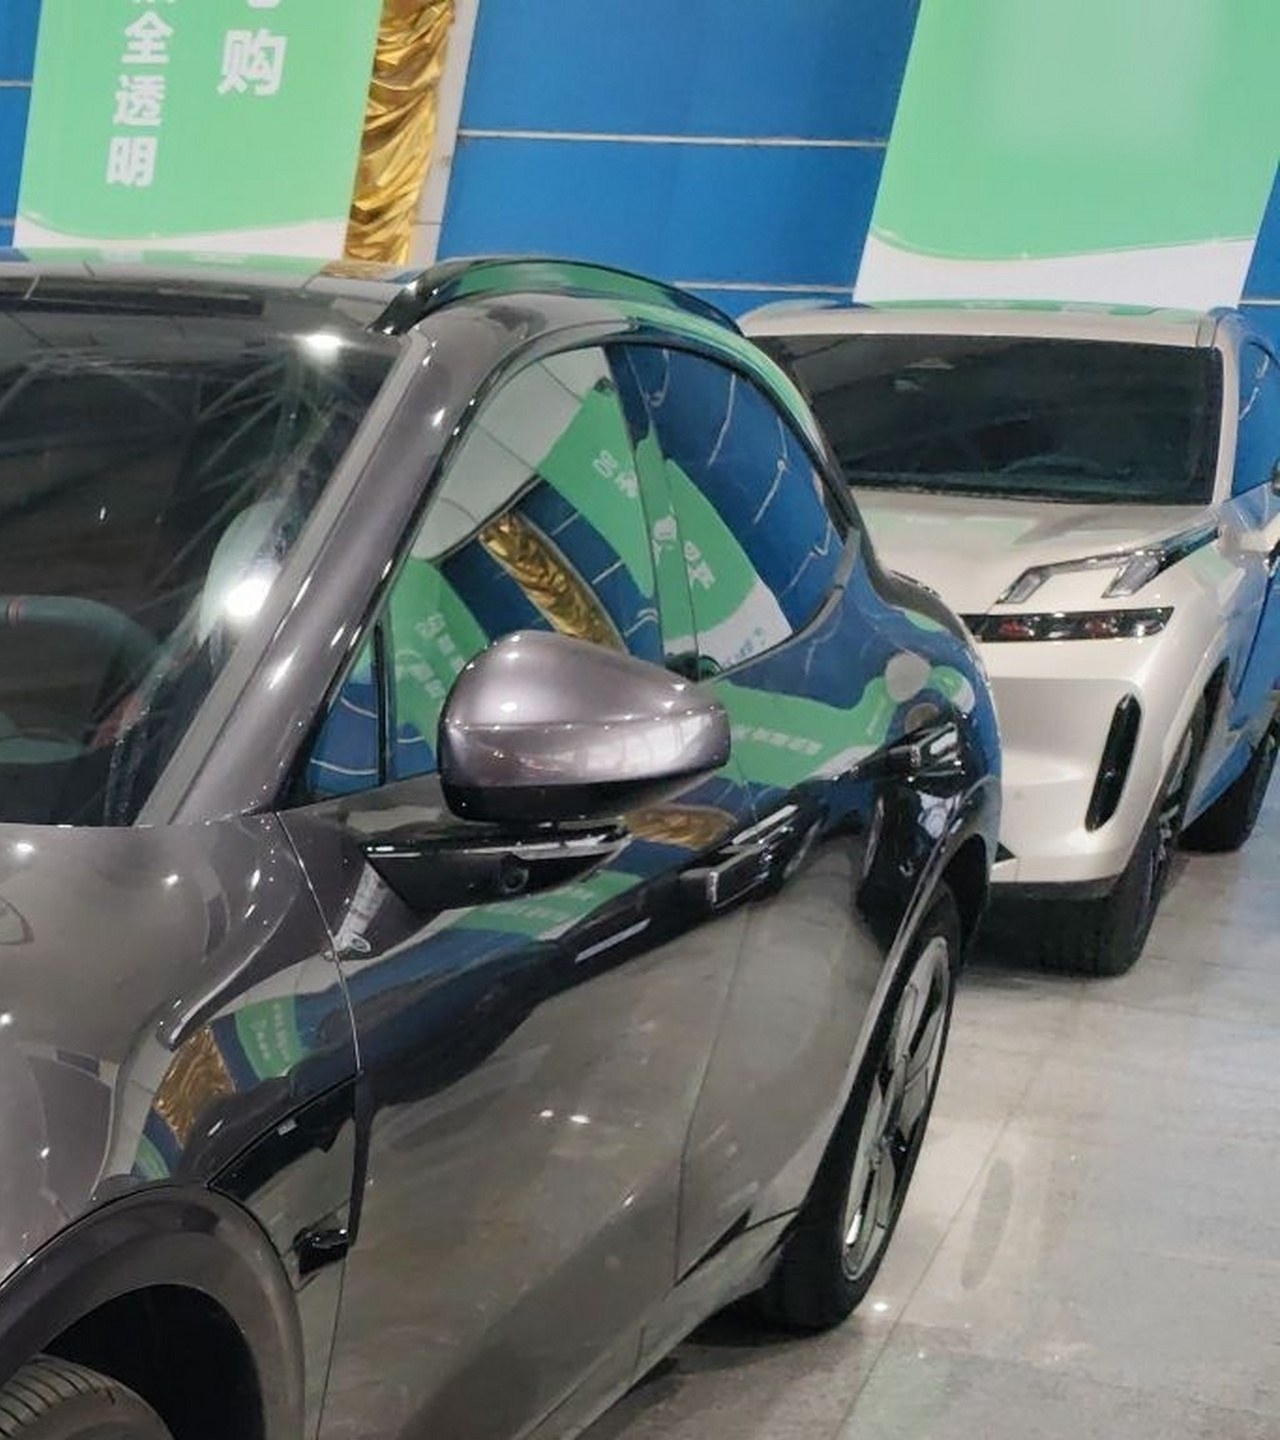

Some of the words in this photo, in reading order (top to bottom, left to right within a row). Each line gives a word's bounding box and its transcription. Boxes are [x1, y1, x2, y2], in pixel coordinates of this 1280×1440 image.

[106, 0, 173, 187] 全透明
[217, 0, 287, 95] 购
